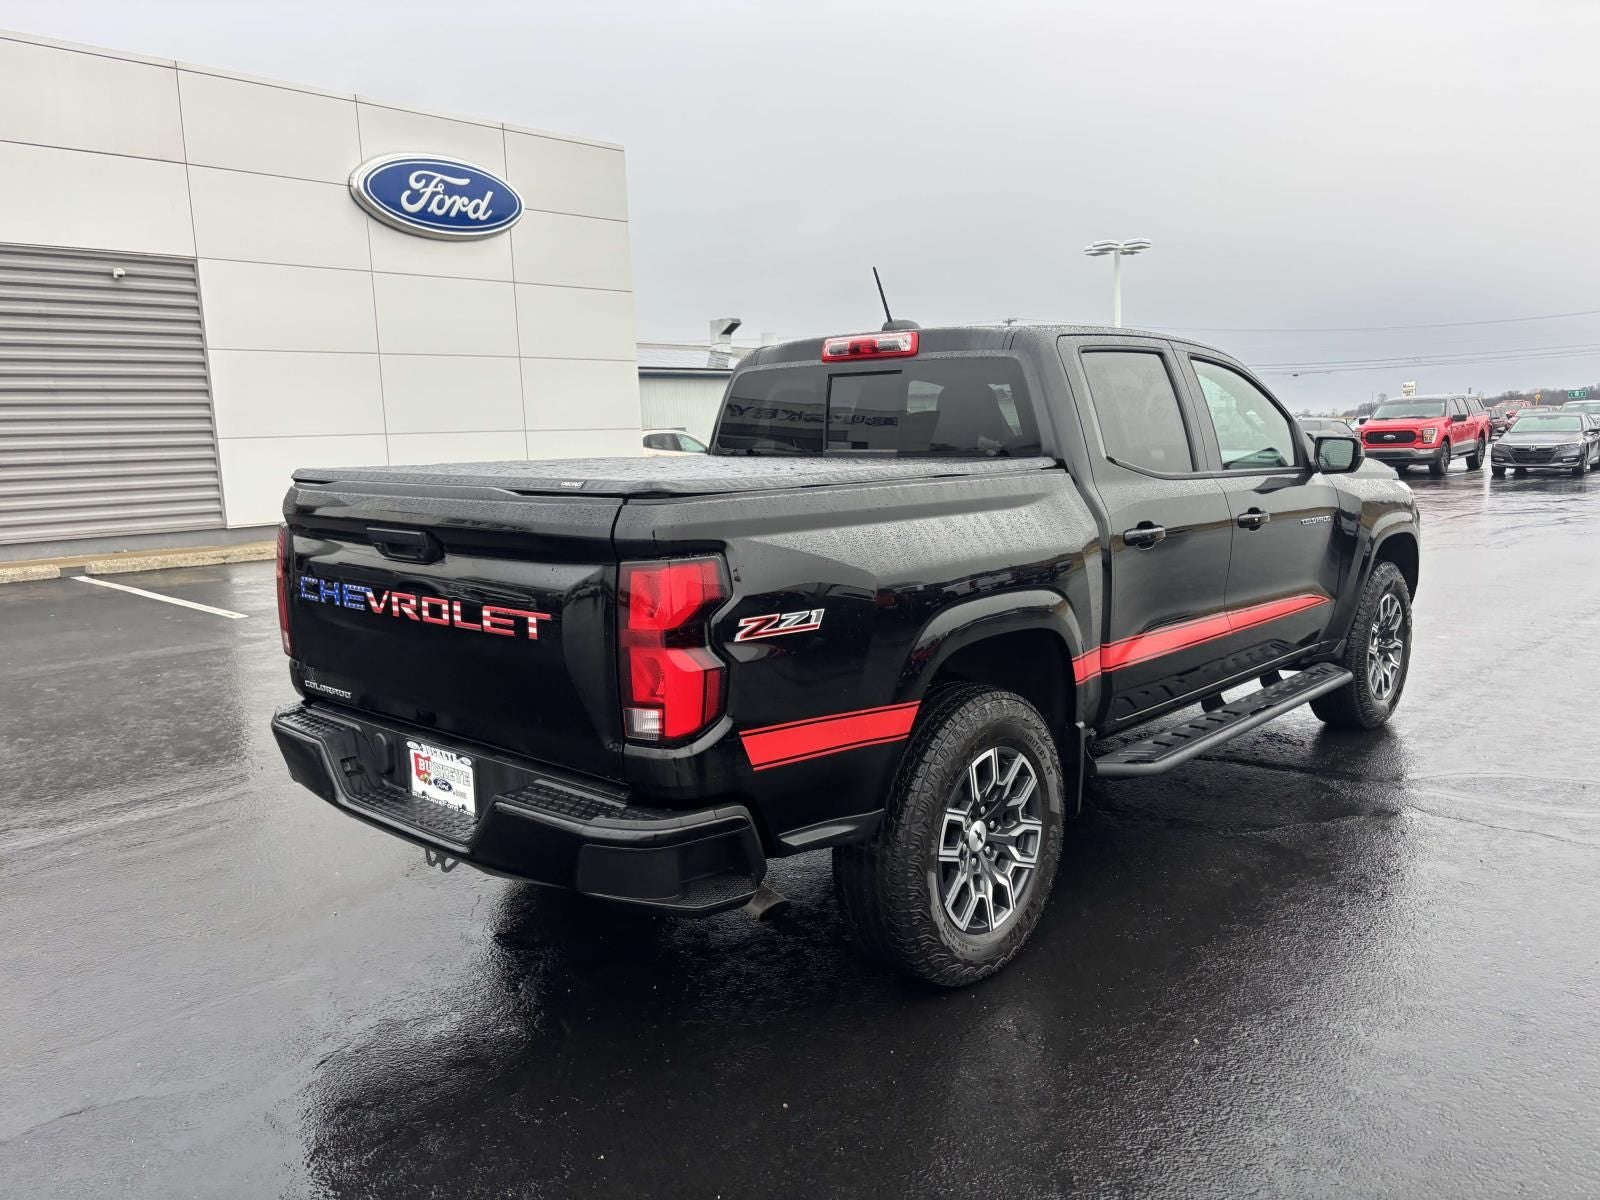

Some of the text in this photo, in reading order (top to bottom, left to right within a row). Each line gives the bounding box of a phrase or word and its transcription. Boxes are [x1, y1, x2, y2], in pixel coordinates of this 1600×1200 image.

[401, 170, 493, 221] Ford
[301, 576, 552, 640] CHEVROLET
[734, 608, 825, 642] Z71
[304, 679, 353, 699] COLORADO
[418, 758, 471, 786] BUCKEYE
